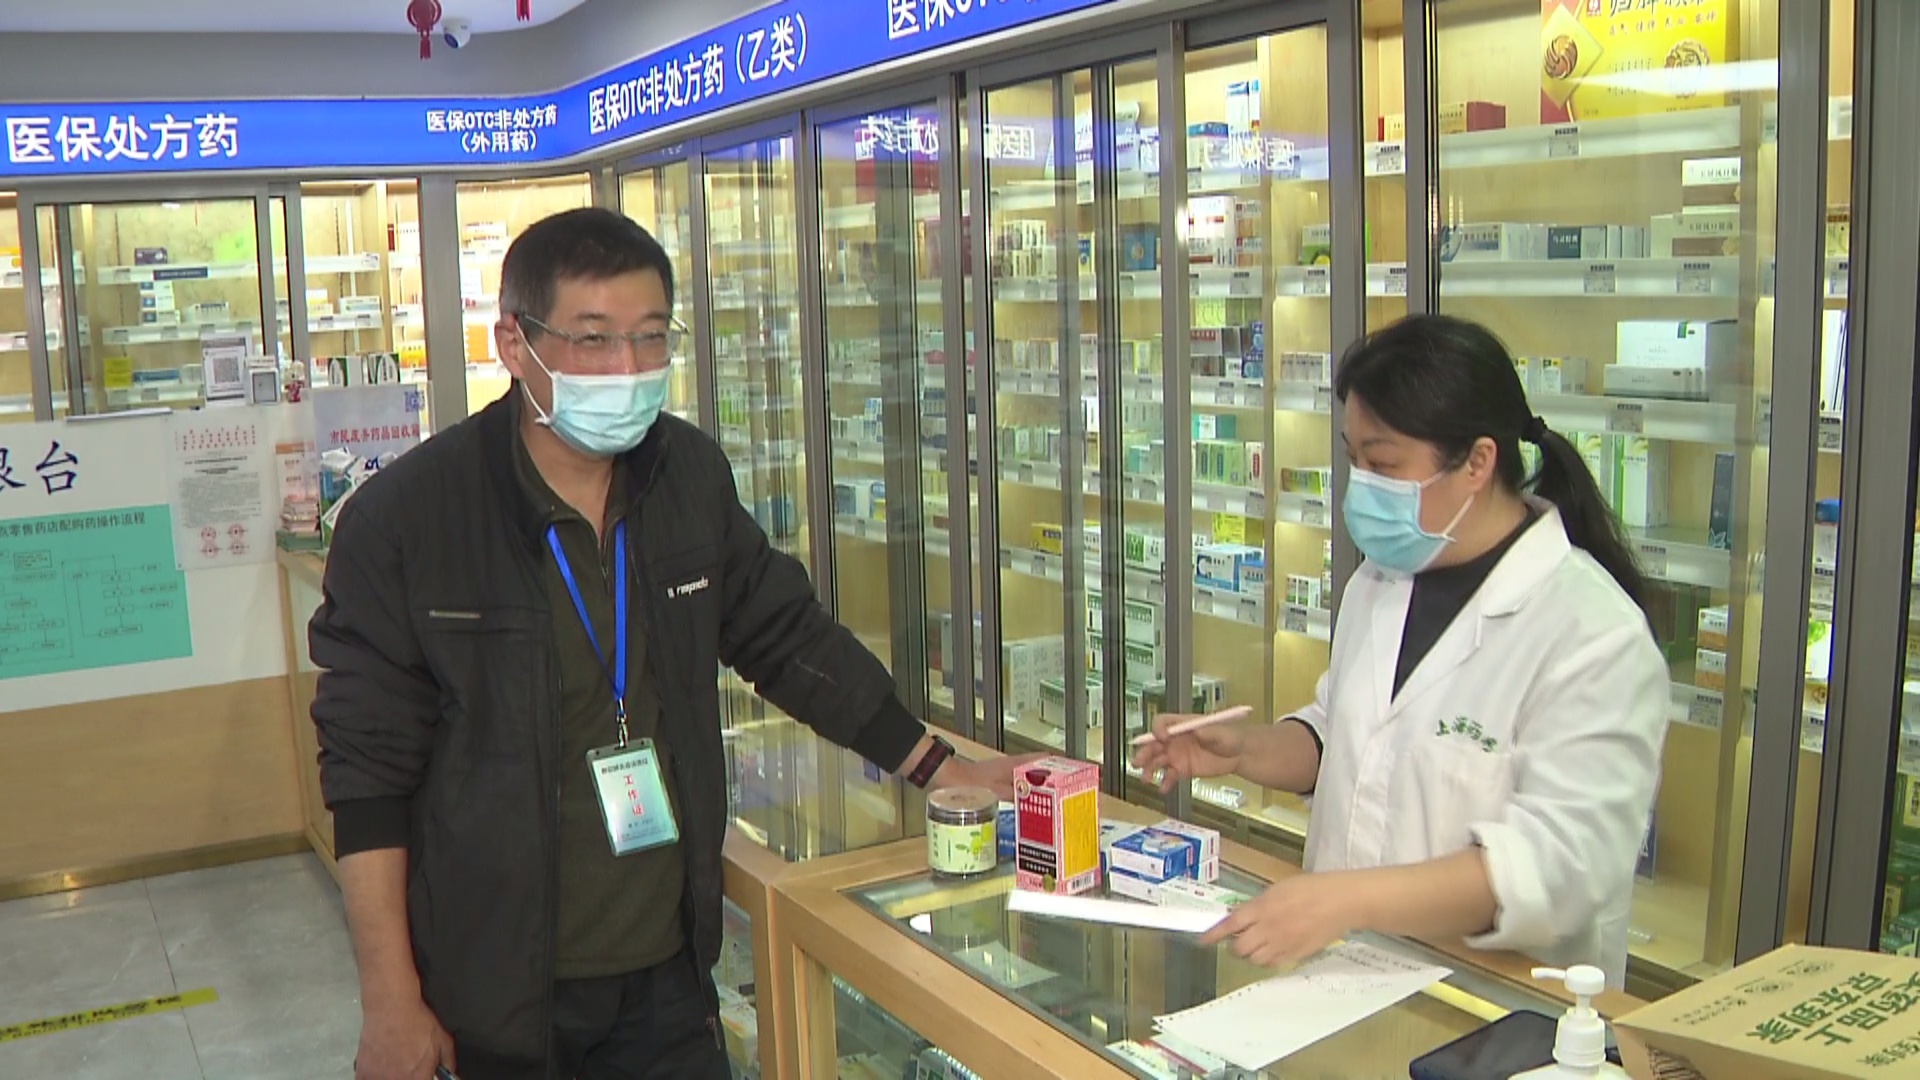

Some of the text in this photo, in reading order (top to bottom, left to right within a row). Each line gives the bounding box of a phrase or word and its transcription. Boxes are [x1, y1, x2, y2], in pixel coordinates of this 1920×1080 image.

[6, 112, 240, 163] 医保处方药
[426, 104, 558, 133] 医保OTC非处方药
[623, 774, 644, 816] 工作证
[1746, 970, 1891, 1045] 京东到家
